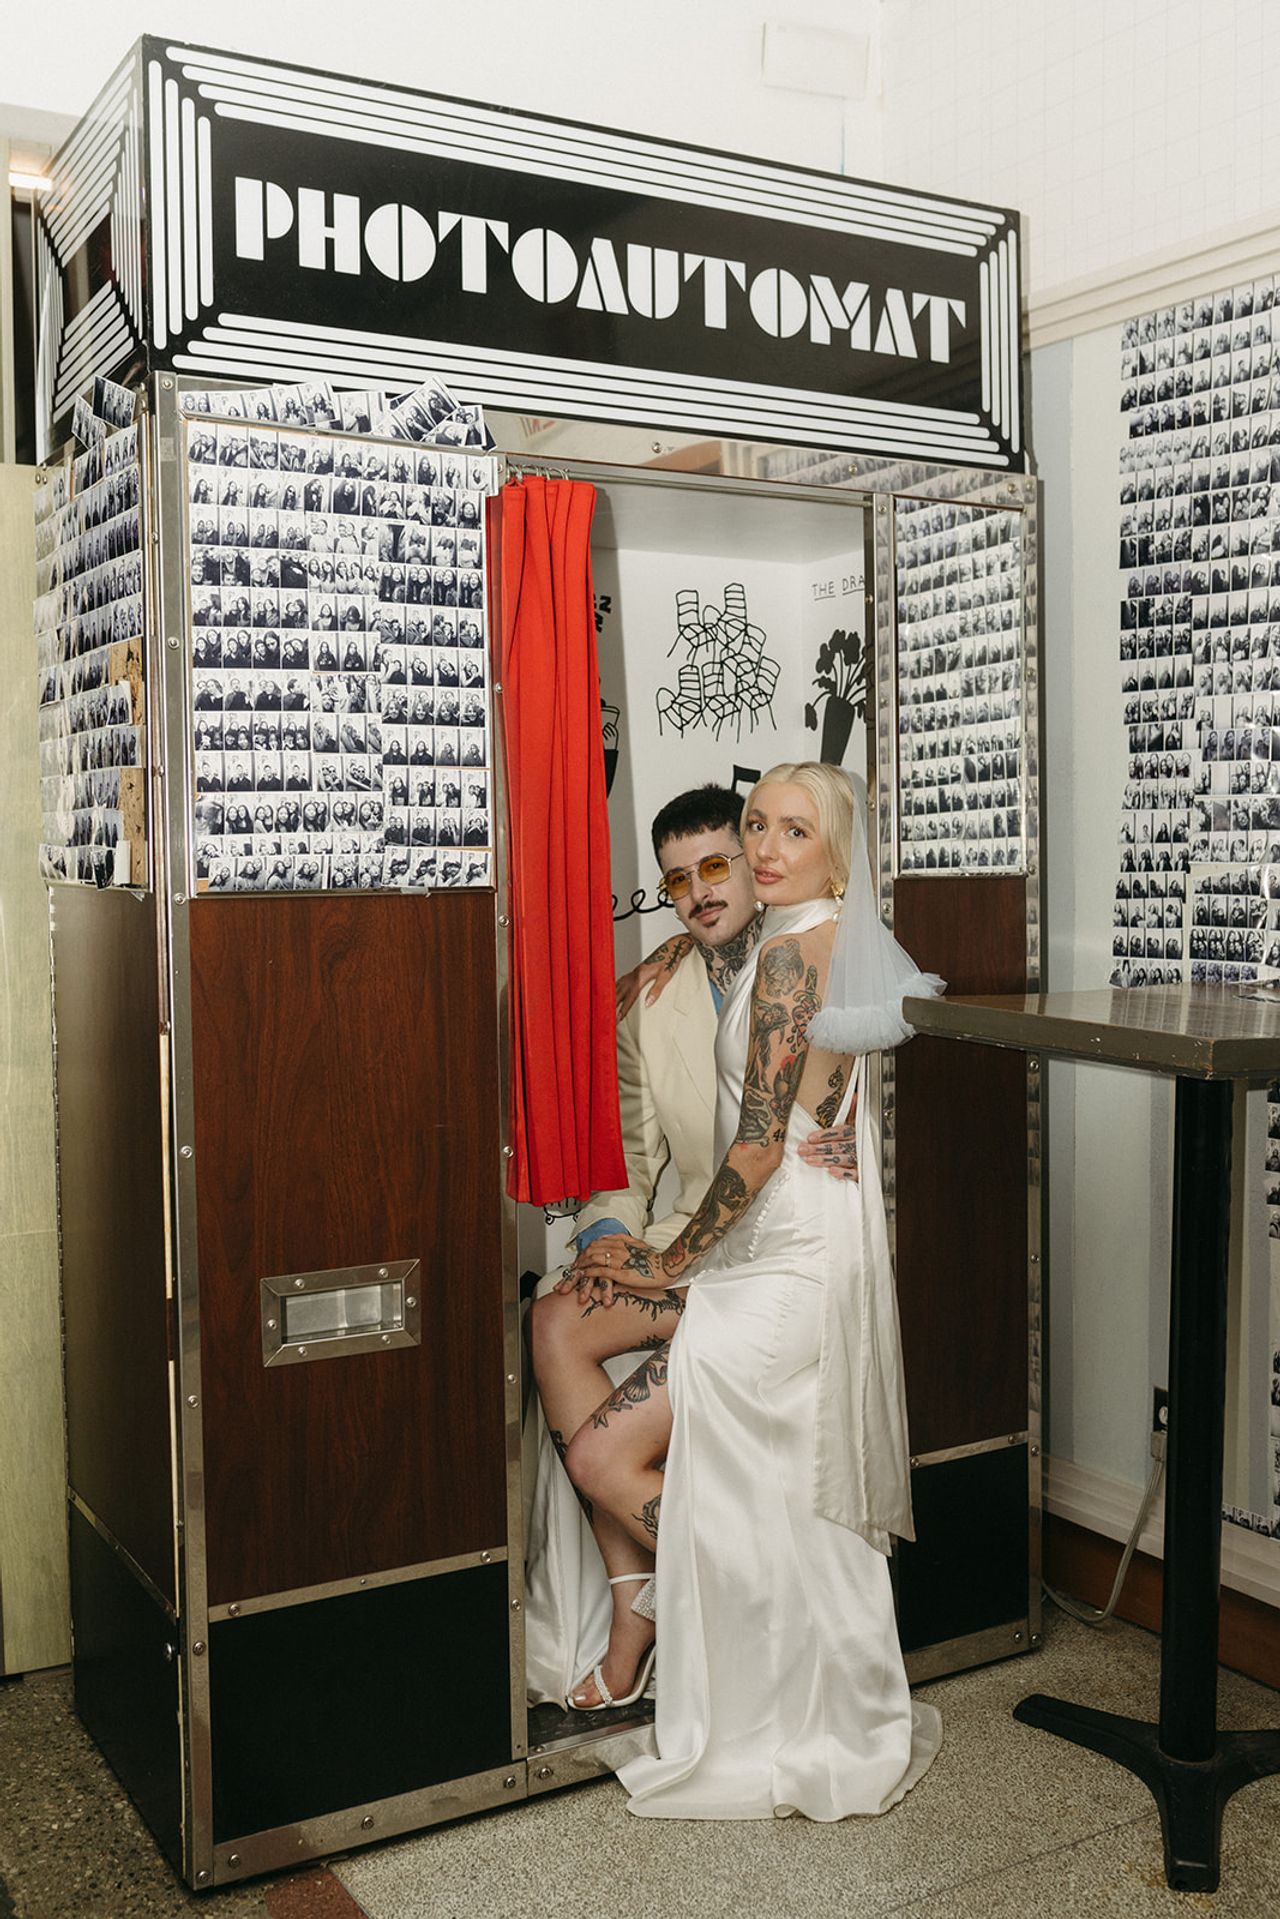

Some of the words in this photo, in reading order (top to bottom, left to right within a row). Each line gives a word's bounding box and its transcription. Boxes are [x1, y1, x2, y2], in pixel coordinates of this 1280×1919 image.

[234, 176, 966, 364] PHOTOAUTOMAT
[812, 581, 834, 596] THE
[842, 575, 865, 591] DRA
